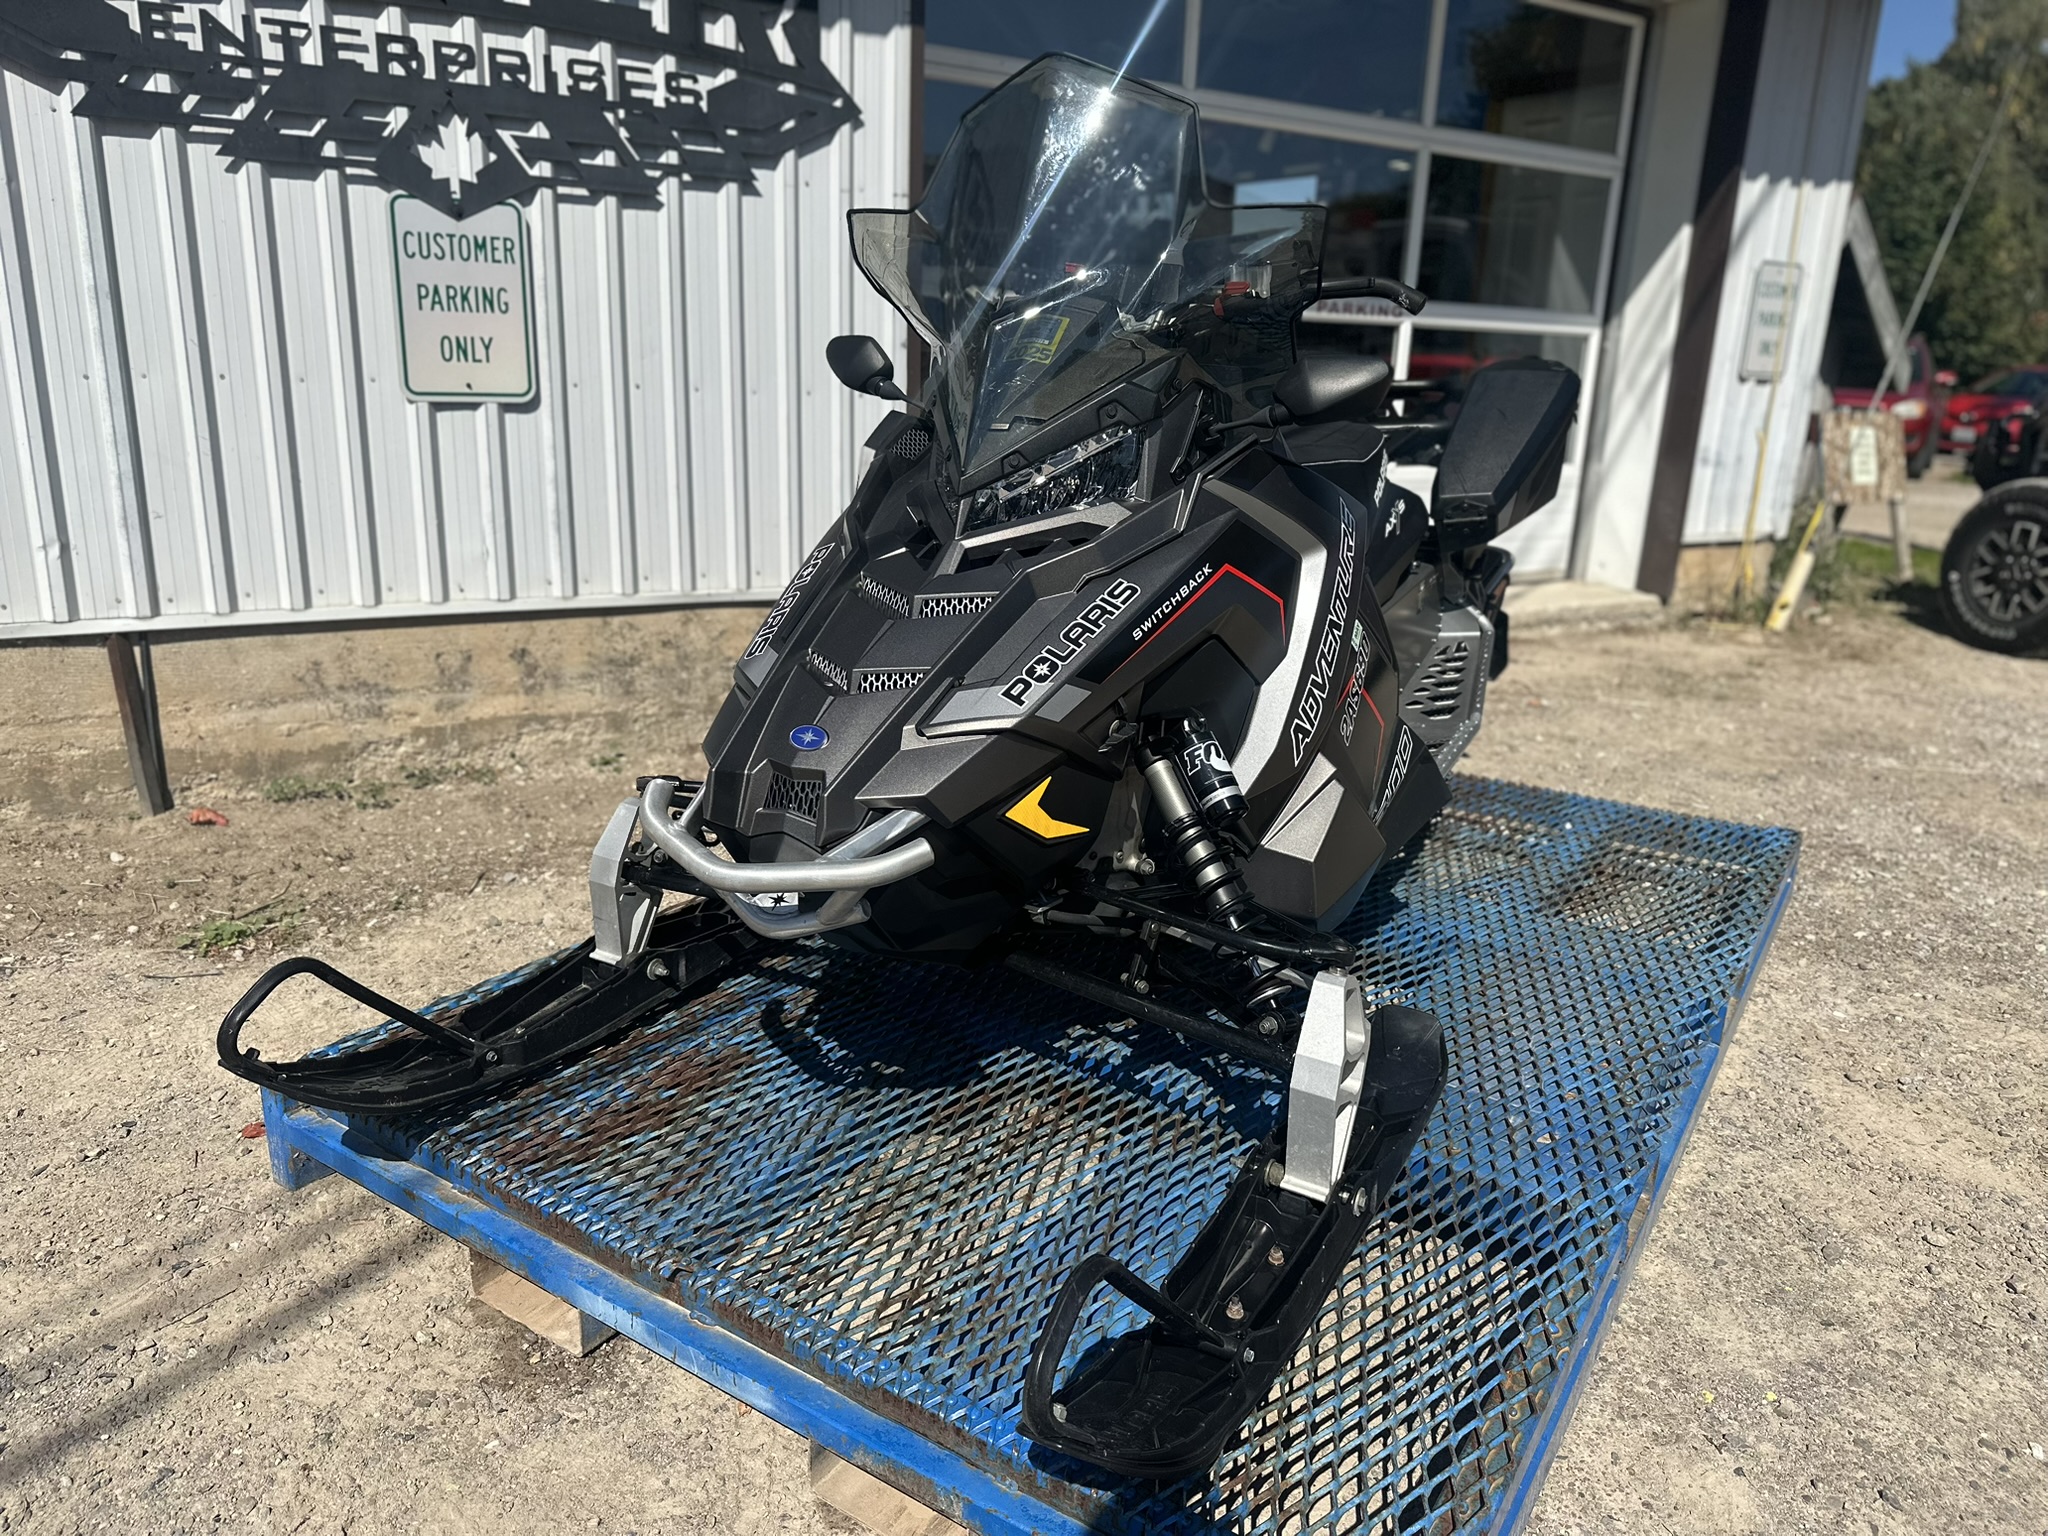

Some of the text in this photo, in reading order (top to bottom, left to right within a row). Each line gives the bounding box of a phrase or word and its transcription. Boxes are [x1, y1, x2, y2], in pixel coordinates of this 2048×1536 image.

[138, 1, 704, 105] ENTERPRISES
[403, 230, 516, 264] CUSTOMER
[417, 283, 509, 315] PARKING
[1317, 300, 1403, 318] PARKING
[440, 335, 493, 363] ONLY
[1007, 344, 1053, 361] 2025
[743, 542, 836, 660] POLARIS
[1132, 563, 1213, 641] SWITCHBACK
[998, 578, 1141, 709] POLARIS
[1290, 496, 1356, 767] ADVENTURE
[1183, 740, 1232, 776] FO
